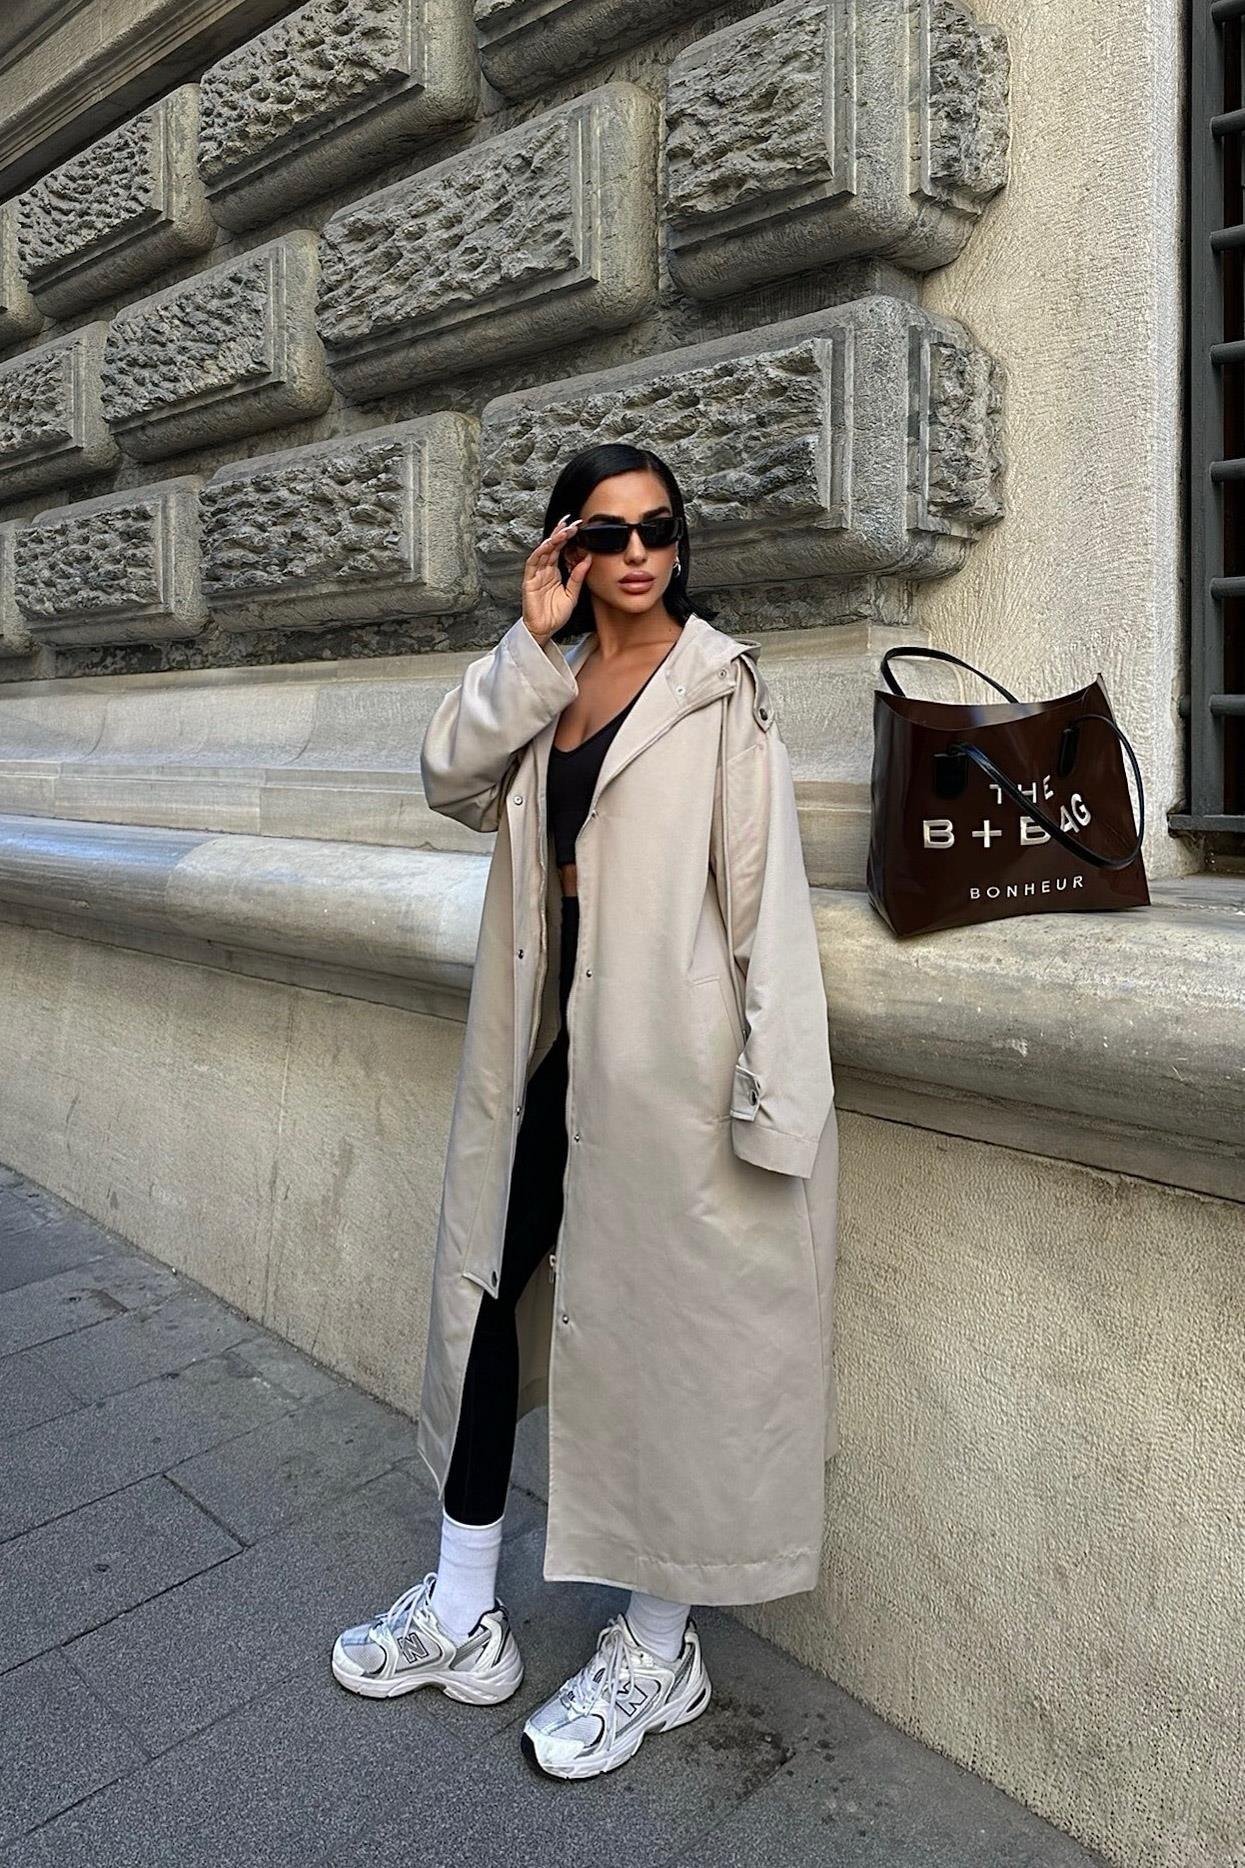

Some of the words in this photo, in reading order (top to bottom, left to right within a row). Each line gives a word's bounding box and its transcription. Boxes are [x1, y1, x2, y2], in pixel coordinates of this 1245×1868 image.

[989, 775, 1055, 805] THE
[969, 875, 1084, 900] BONHEUR
[397, 1632, 430, 1664] N
